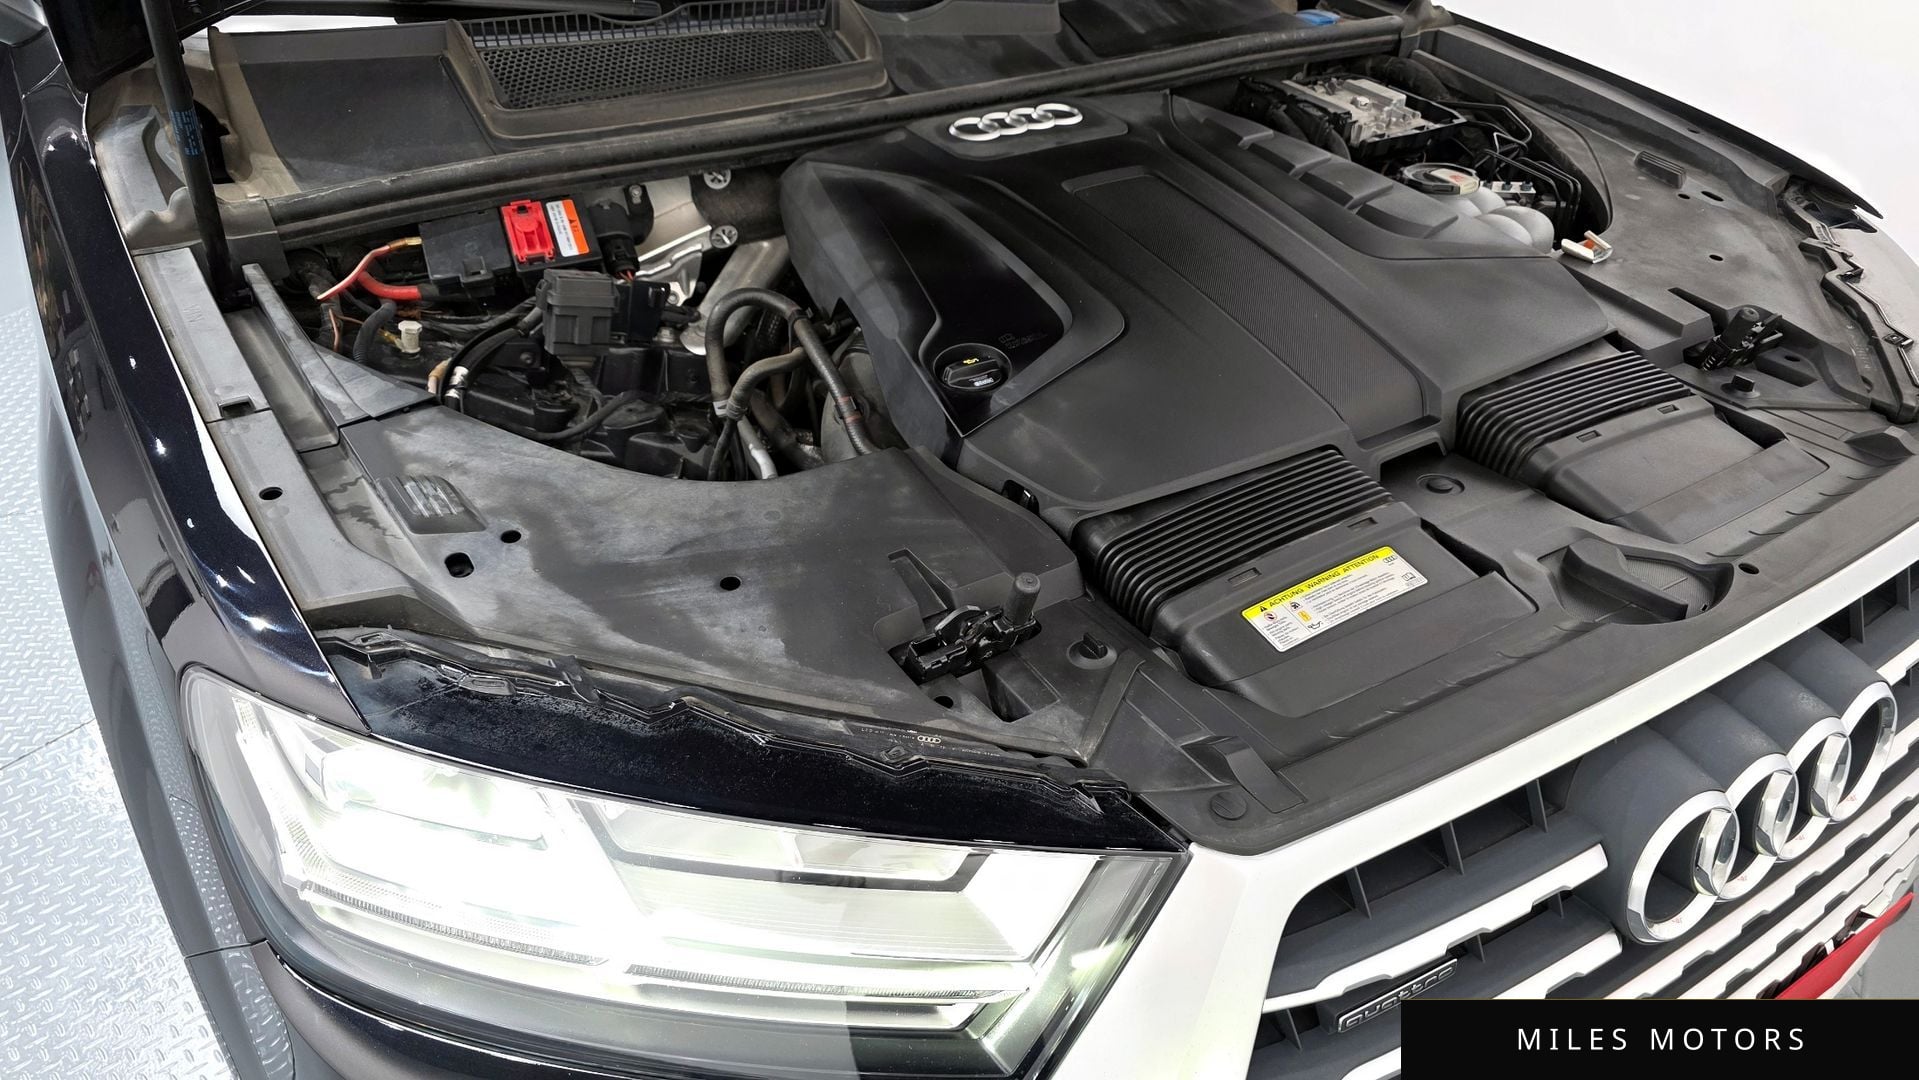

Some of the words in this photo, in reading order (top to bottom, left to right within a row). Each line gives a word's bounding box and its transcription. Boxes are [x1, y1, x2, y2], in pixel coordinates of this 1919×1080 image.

[1269, 588, 1304, 607] ACHTUNG
[1306, 570, 1340, 590] WARNING
[1342, 554, 1379, 573] ATTENTION
[1346, 966, 1454, 1028] quattro
